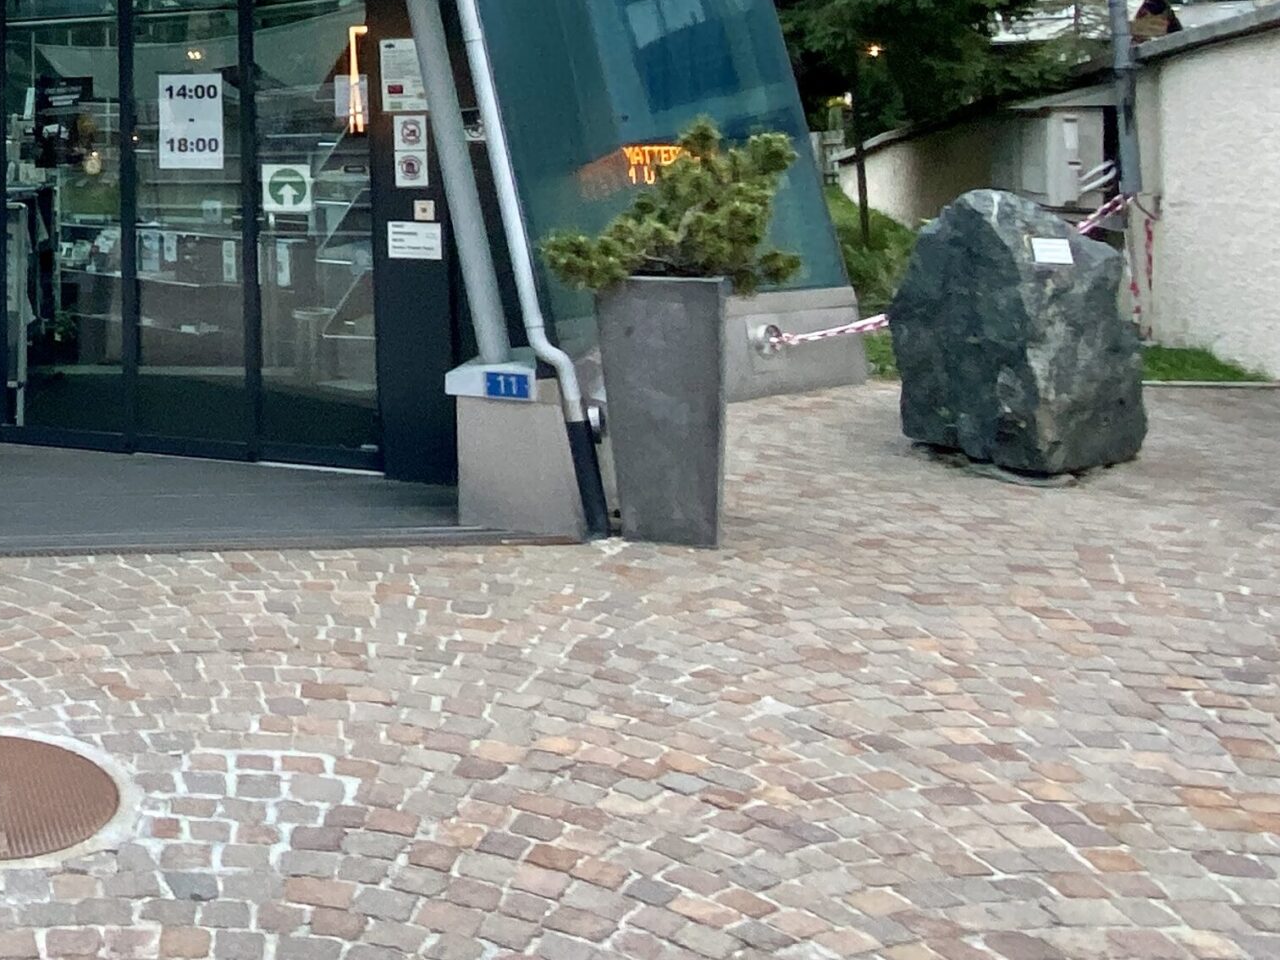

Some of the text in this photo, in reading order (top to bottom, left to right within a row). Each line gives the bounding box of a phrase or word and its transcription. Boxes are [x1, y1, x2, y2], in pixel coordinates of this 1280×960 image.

[164, 84, 218, 100] 14:00
[165, 137, 219, 153] 18:00
[497, 375, 518, 394] 11
